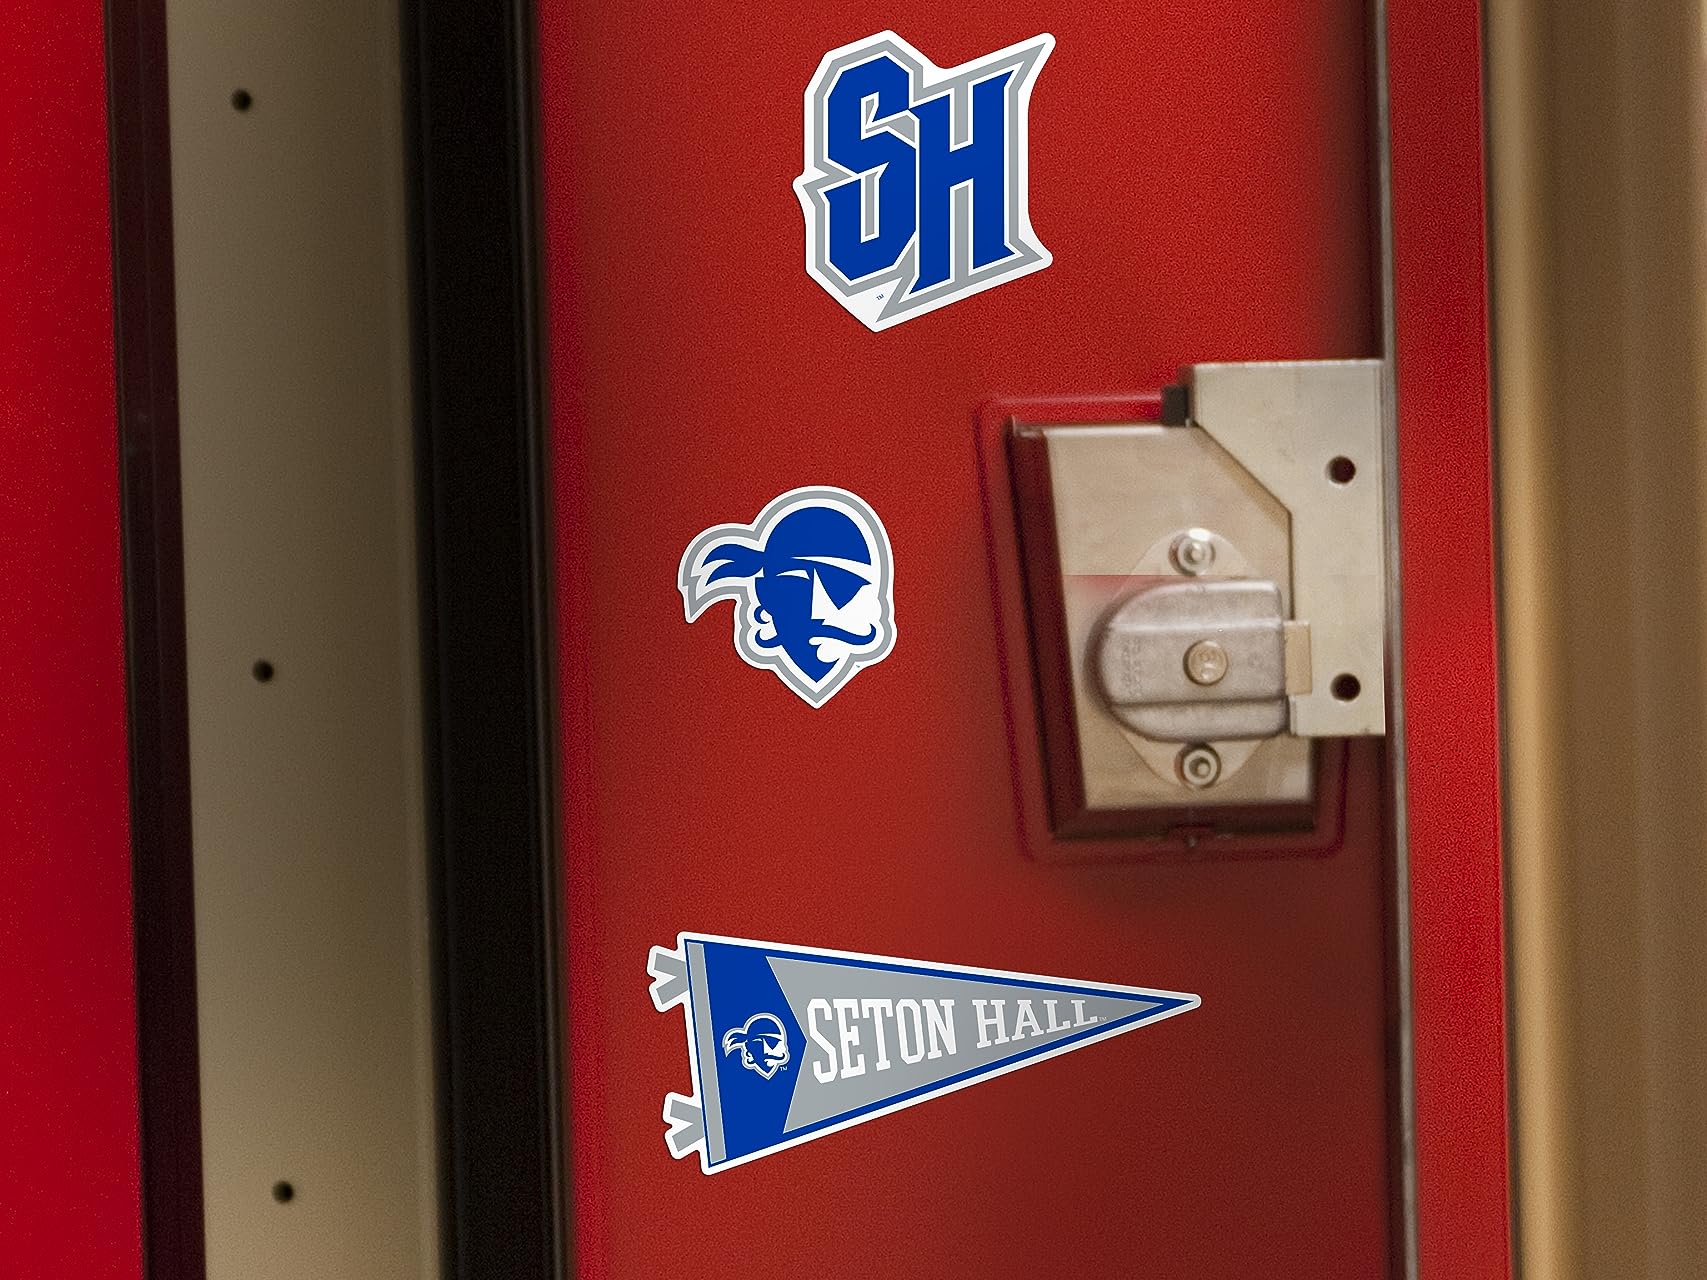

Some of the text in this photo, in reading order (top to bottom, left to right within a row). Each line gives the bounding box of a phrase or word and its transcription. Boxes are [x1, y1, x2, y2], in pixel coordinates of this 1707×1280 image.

[822, 55, 1016, 295] SH
[806, 998, 957, 1084] SETON
[971, 999, 1098, 1049] HALL
